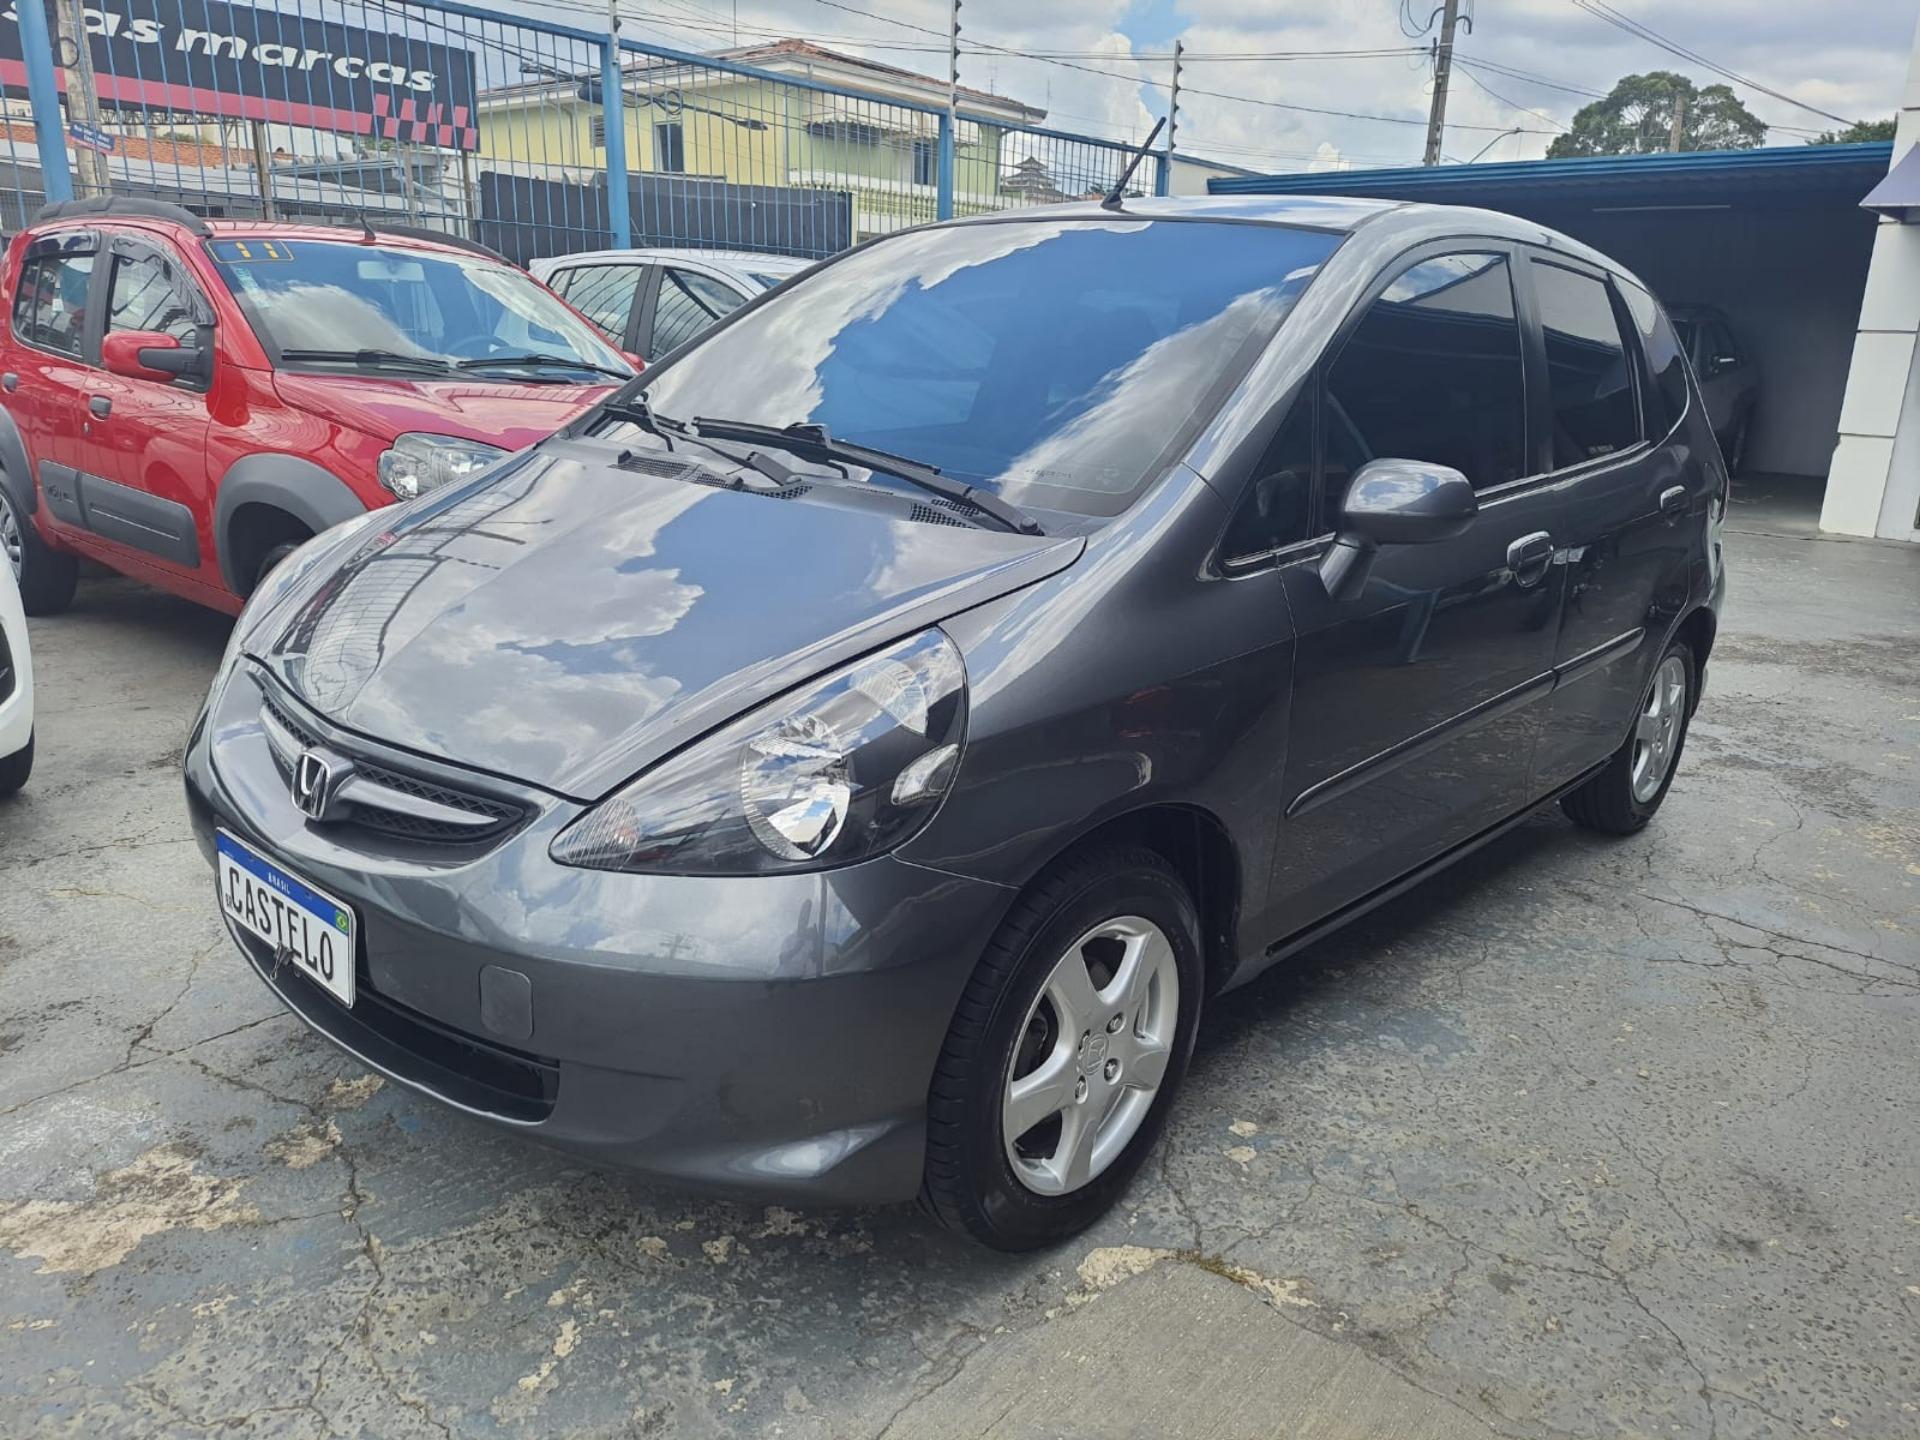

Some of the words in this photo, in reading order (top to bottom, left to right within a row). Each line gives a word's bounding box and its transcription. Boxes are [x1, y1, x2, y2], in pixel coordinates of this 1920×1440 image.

[175, 28, 438, 92] marcas
[268, 871, 291, 896] BRASIL
[228, 865, 335, 983] CASTELO
